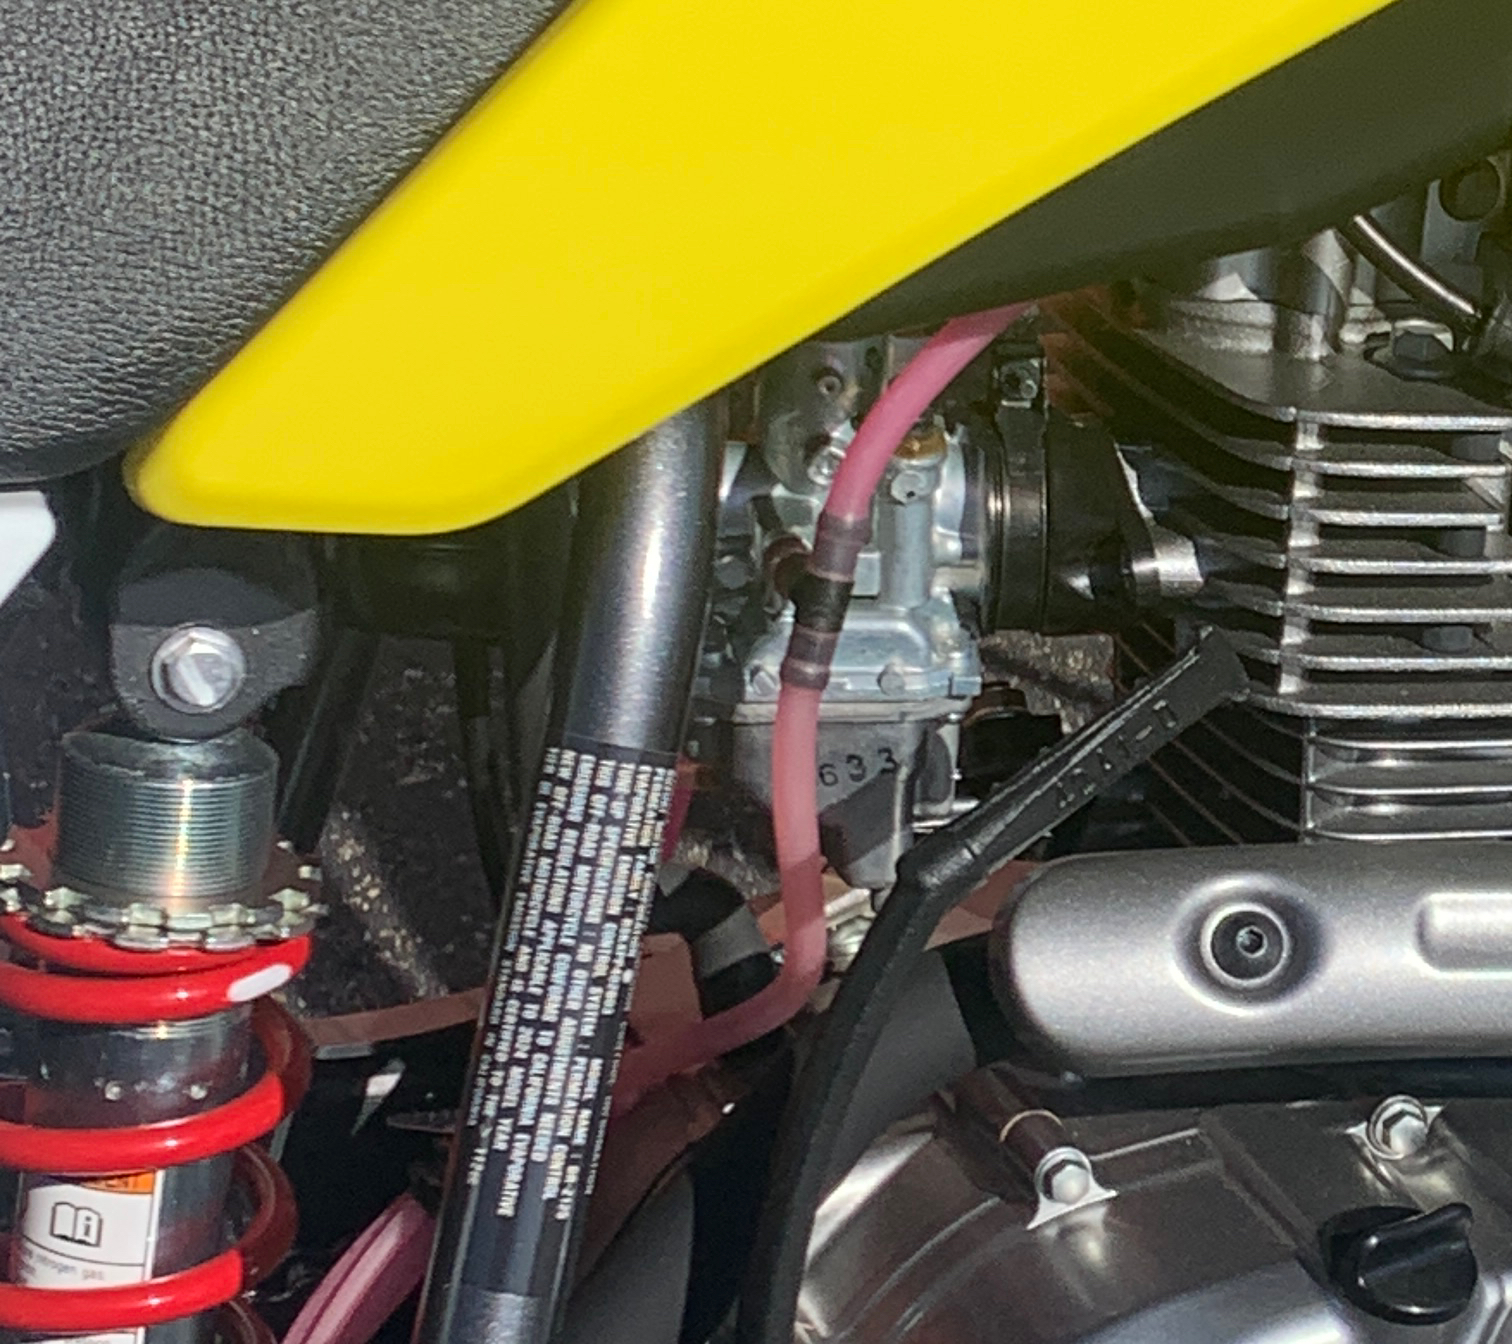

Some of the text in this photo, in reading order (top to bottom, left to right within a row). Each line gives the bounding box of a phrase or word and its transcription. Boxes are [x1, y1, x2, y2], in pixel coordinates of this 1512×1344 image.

[590, 921, 618, 979] CONTROL
[577, 985, 604, 1037] SYSTEM
[540, 1143, 569, 1201] CONTROL
